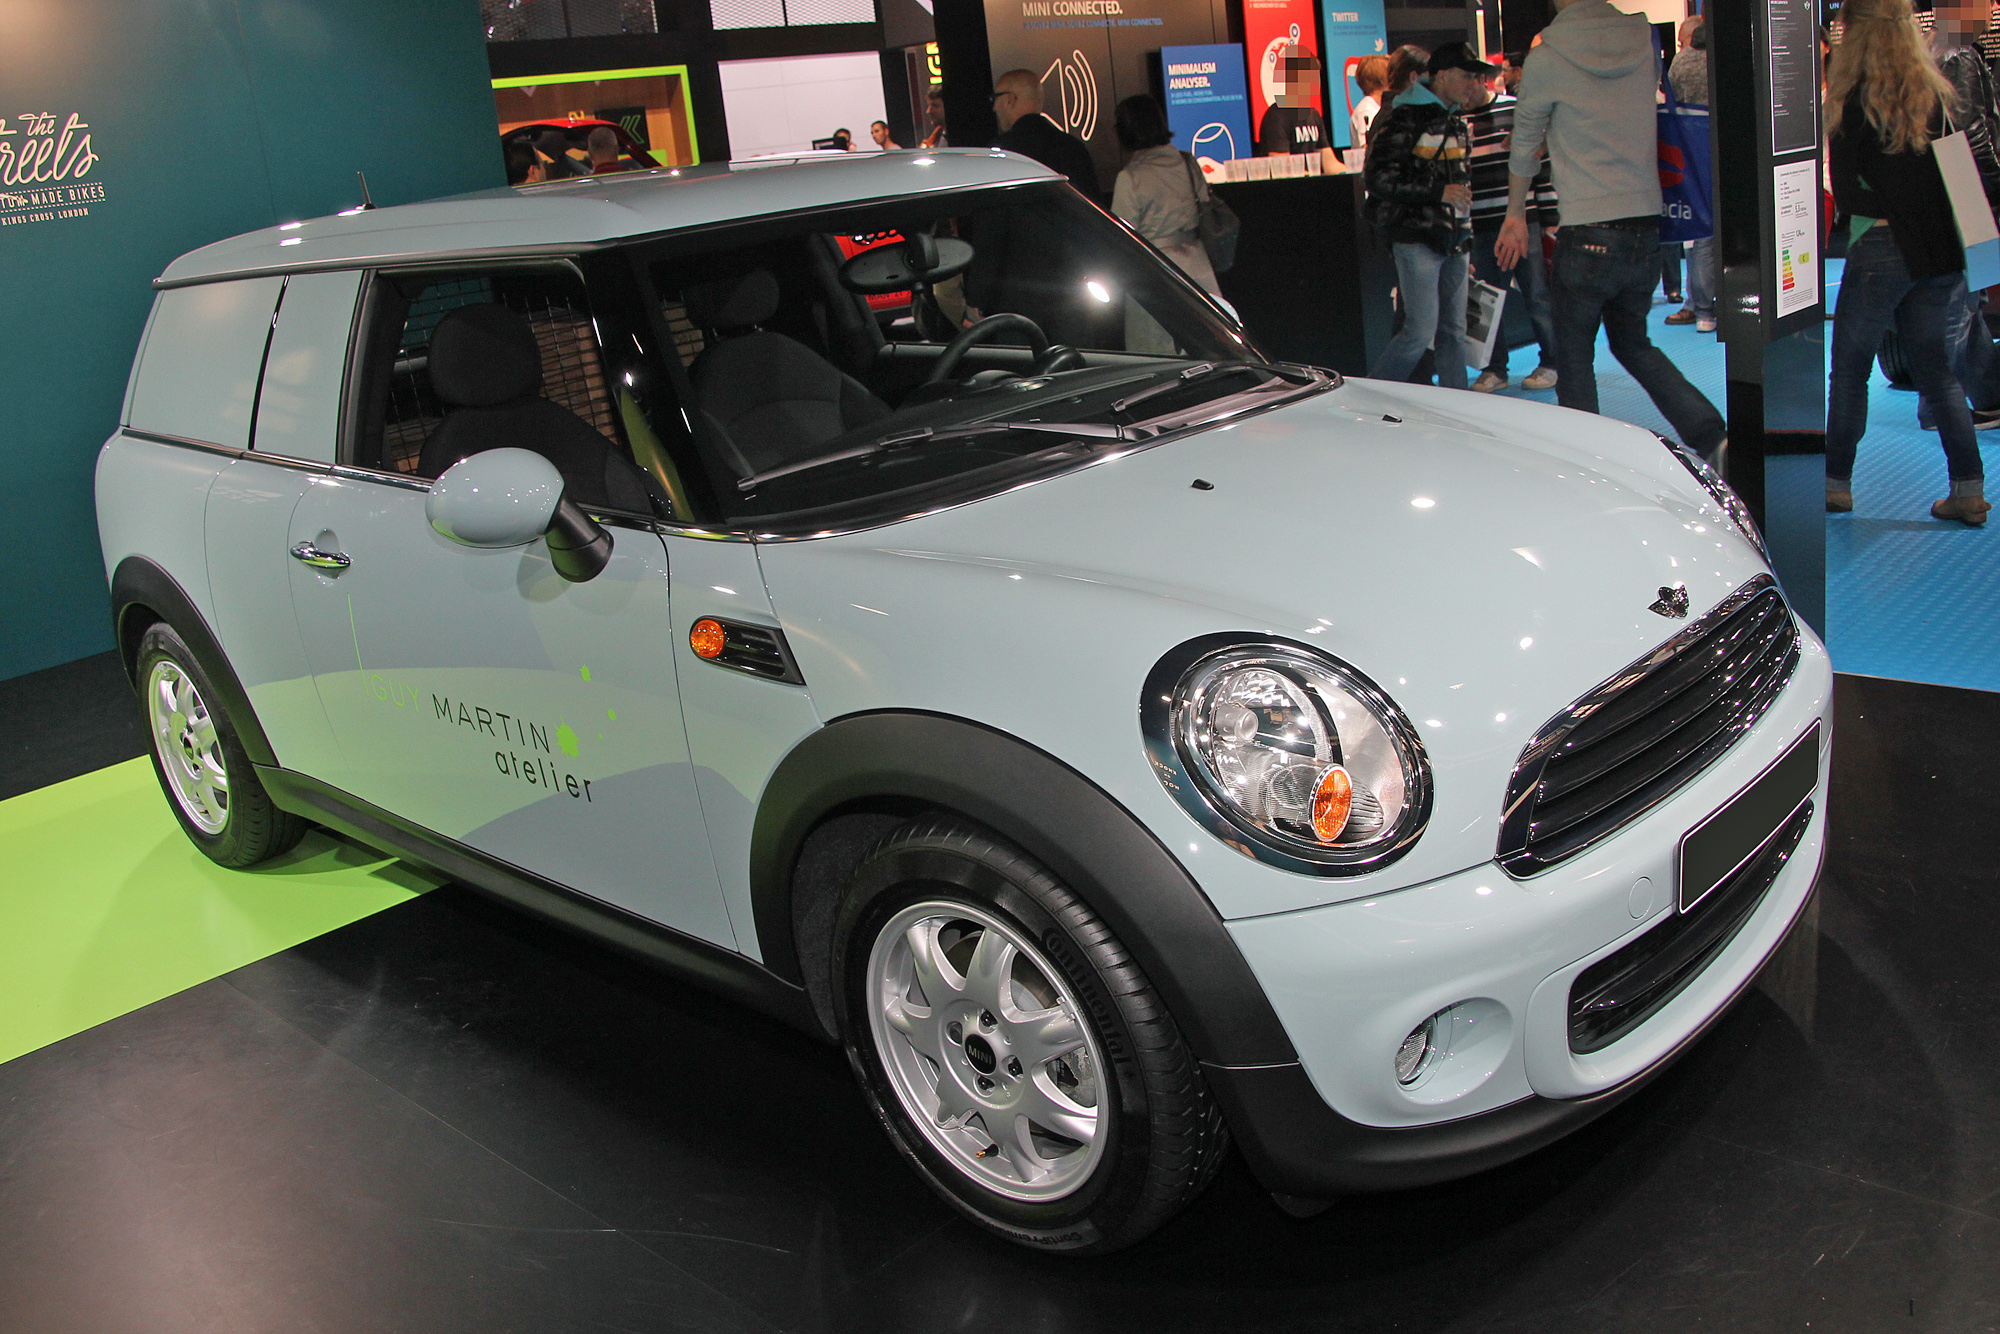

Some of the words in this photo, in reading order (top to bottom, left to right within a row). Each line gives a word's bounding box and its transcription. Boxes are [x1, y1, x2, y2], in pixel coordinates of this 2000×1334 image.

[1022, 2, 1050, 17] MINI
[1052, 0, 1123, 16] CONNECTED.
[1332, 12, 1359, 22] TWITTER
[1168, 62, 1217, 76] MINIMALISM
[1169, 76, 1212, 90] ANALYSER.
[18, 111, 57, 137] the
[0, 112, 99, 186] reets
[30, 190, 64, 206] MADE
[68, 185, 106, 201] BIKES
[1, 215, 27, 226] KINGS
[29, 212, 55, 223] CROSS
[58, 207, 89, 219] LONDON
[370, 674, 419, 712] GUY
[432, 693, 551, 754] MARTIN
[495, 750, 592, 803] atelier
[1042, 927, 1132, 1065] Continental
[968, 1044, 992, 1066] MINI
